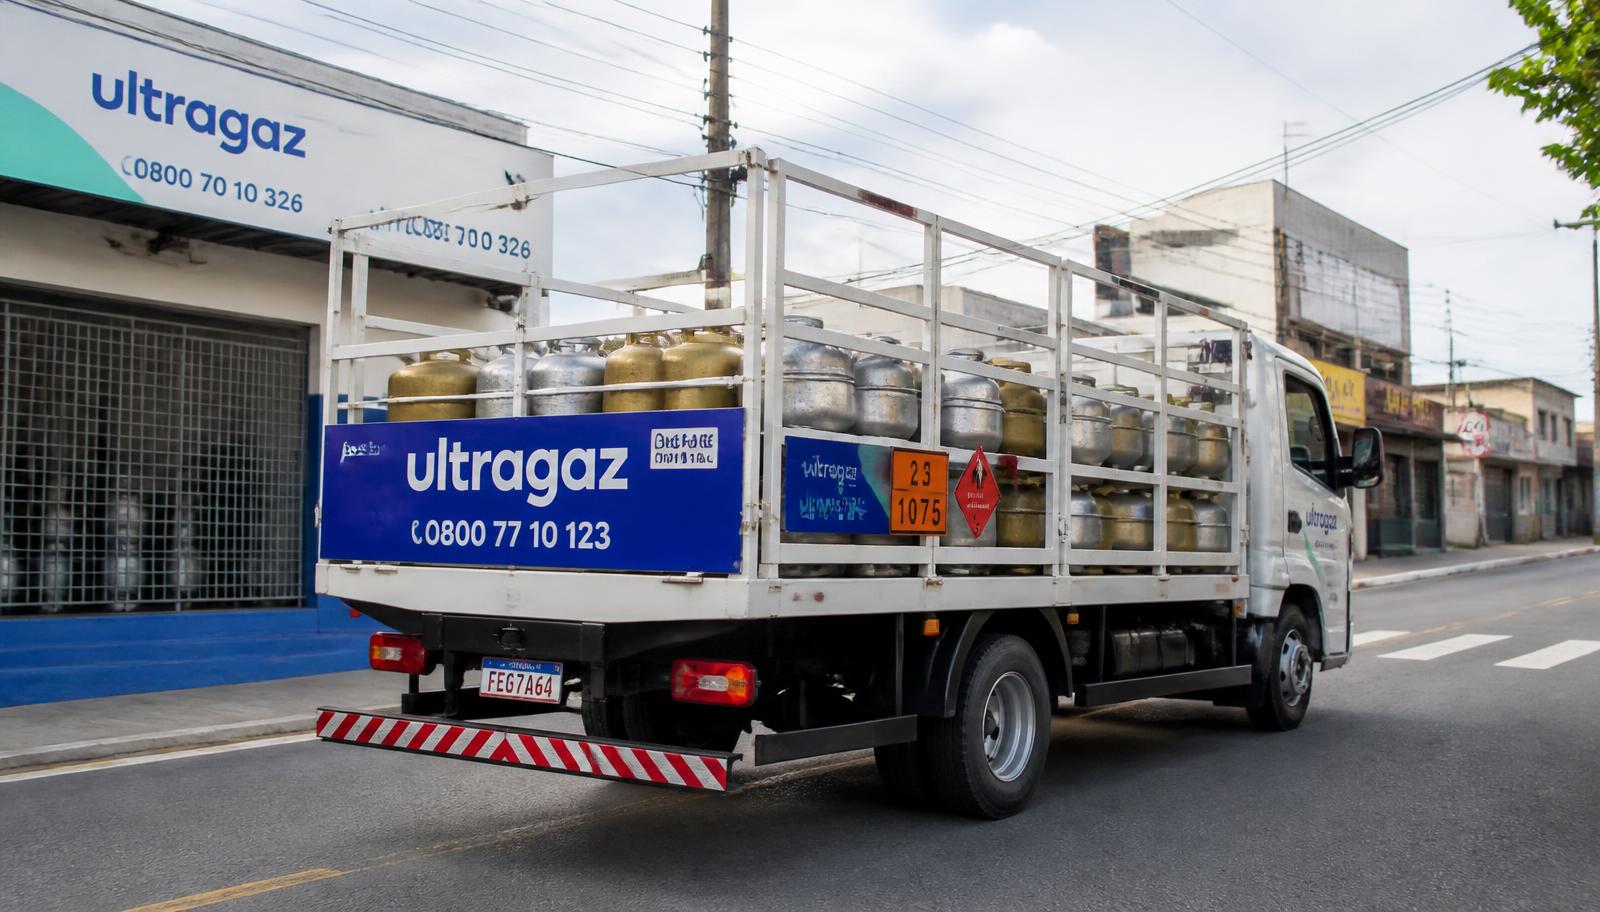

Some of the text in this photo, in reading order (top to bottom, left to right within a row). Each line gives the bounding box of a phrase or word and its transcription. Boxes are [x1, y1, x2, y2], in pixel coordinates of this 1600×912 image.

[92, 69, 306, 158] ultragaz
[134, 158, 303, 213] 0800 70 10 326
[498, 234, 531, 259] 326
[407, 437, 628, 507] ultragaz
[911, 460, 931, 486] 23
[898, 497, 941, 526] 1075
[425, 519, 611, 550] 0800 77 10 123
[487, 670, 553, 698] FEG7A64
